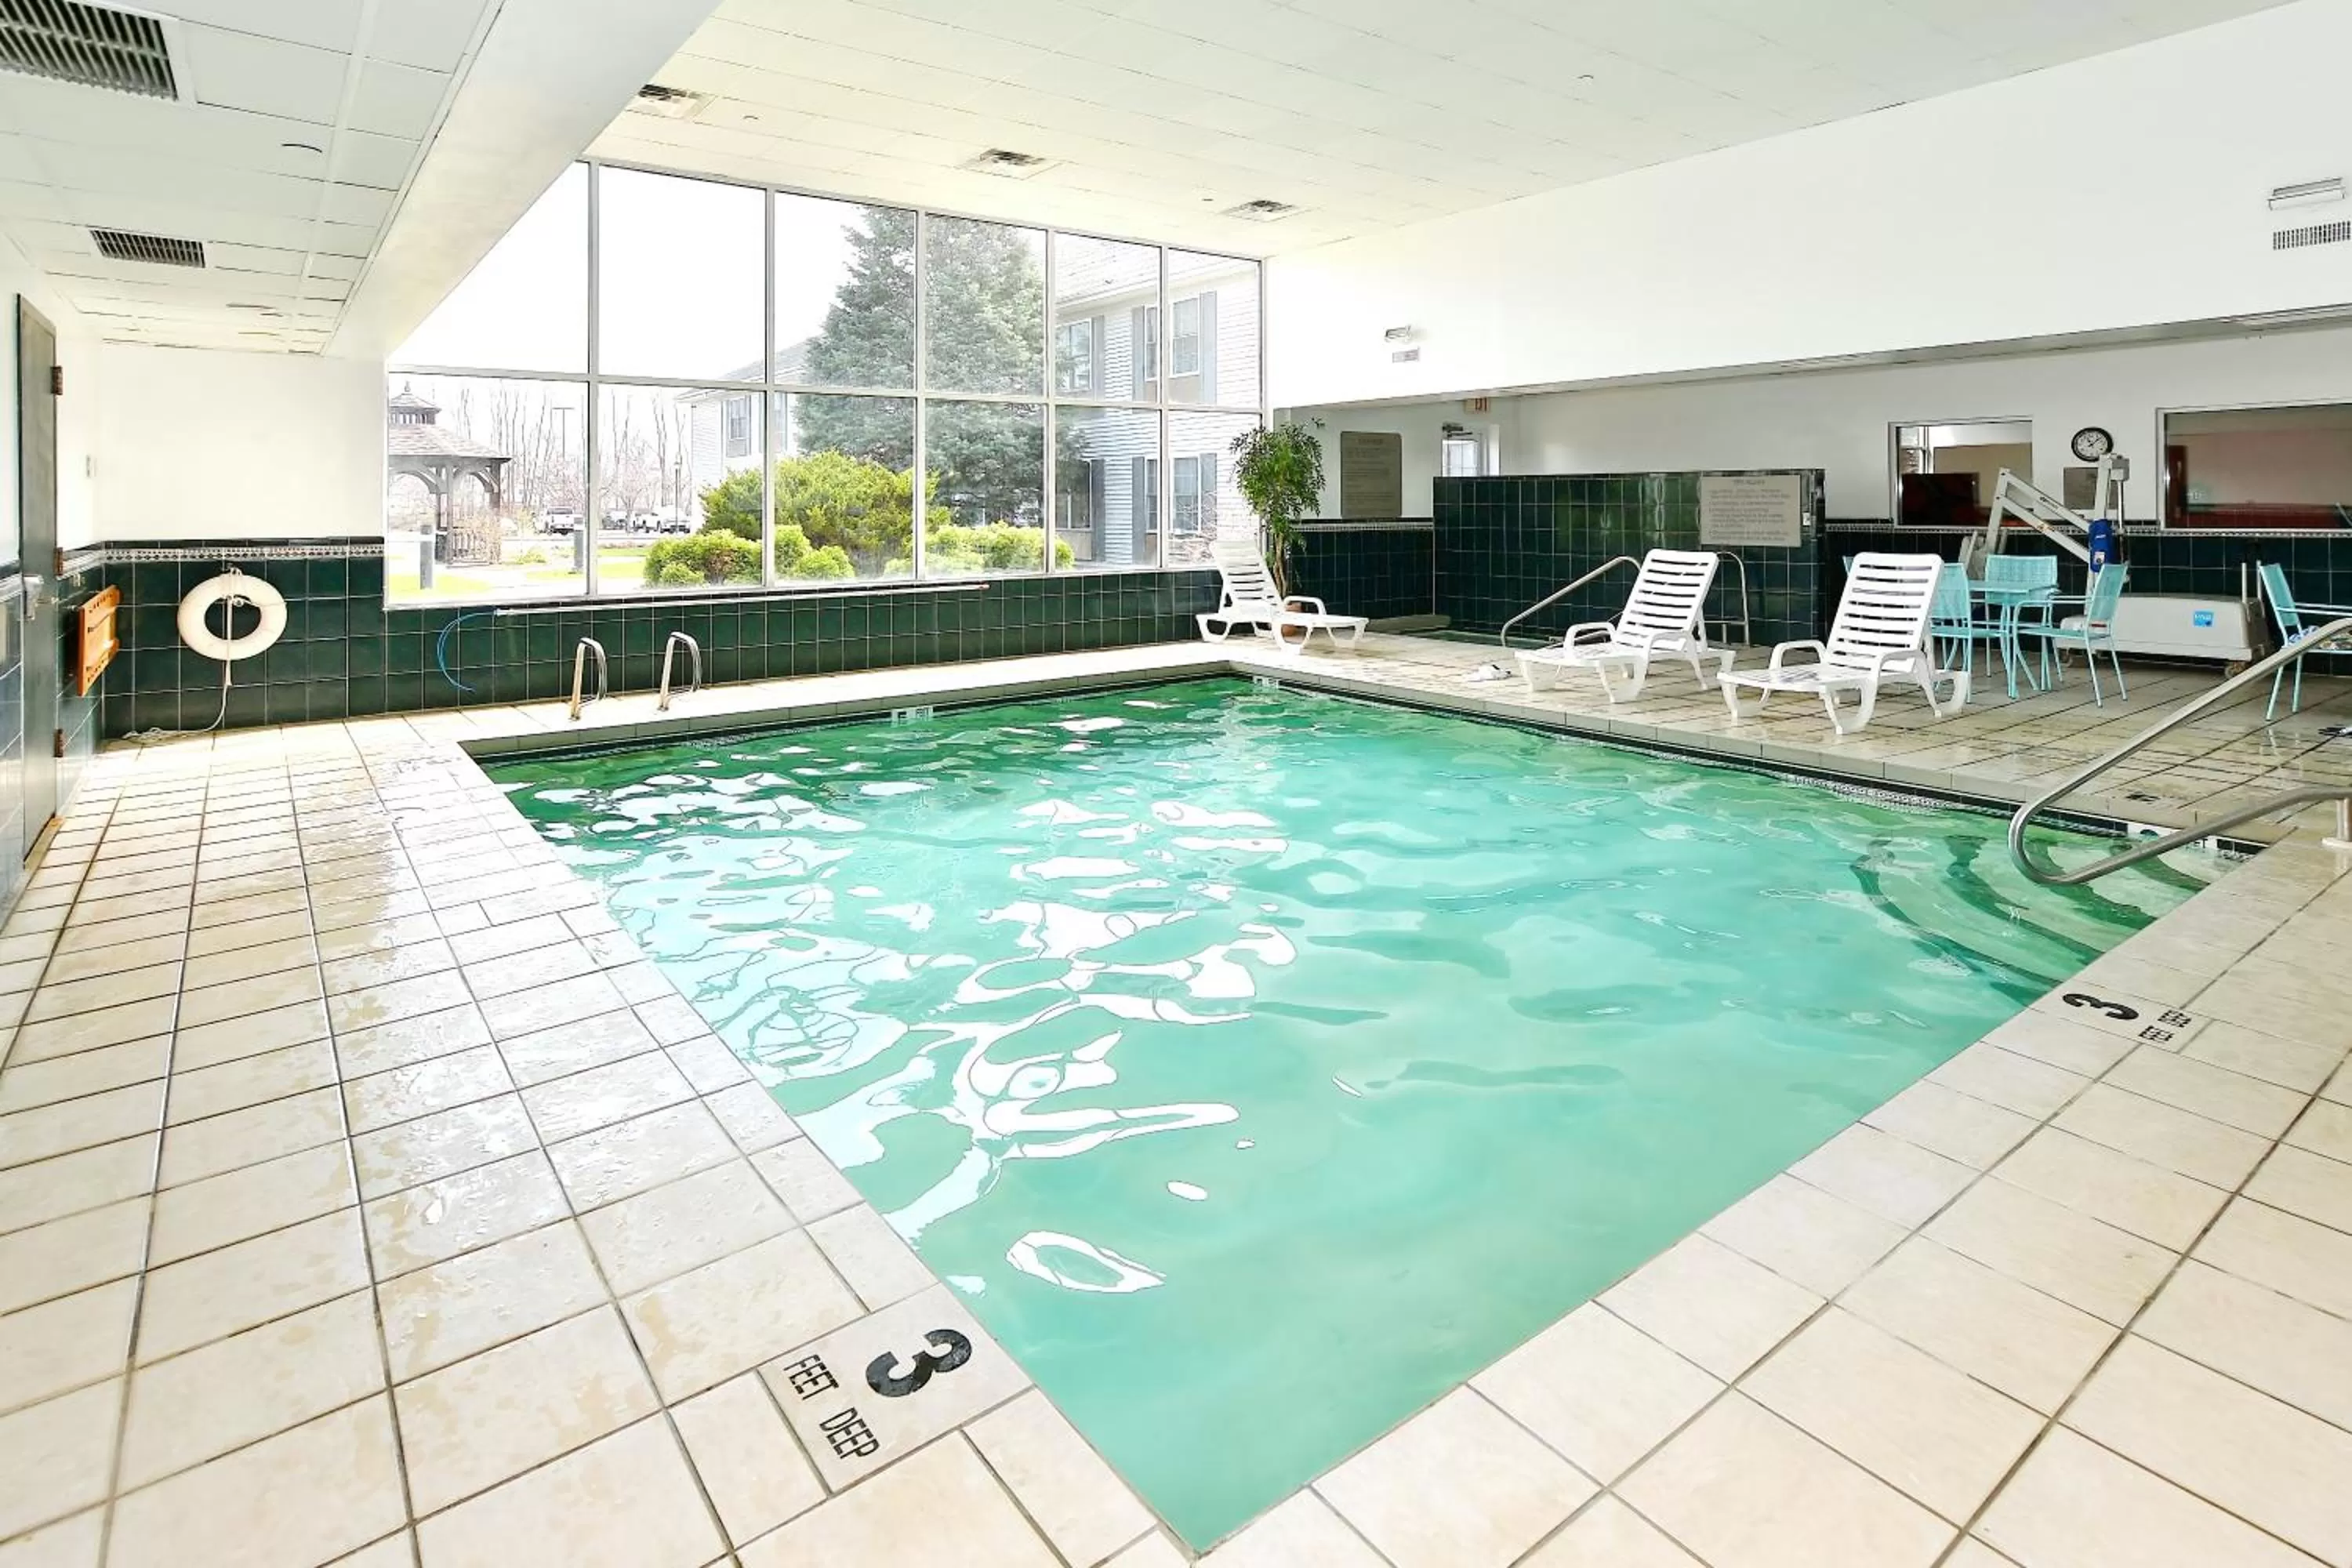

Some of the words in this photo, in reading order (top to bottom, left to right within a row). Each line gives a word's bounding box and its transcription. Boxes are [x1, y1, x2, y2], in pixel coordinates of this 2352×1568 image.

[2062, 993, 2140, 1021] 3
[866, 1329, 972, 1398] 3
[783, 1354, 840, 1400] FEET
[819, 1407, 880, 1459] DEEP
